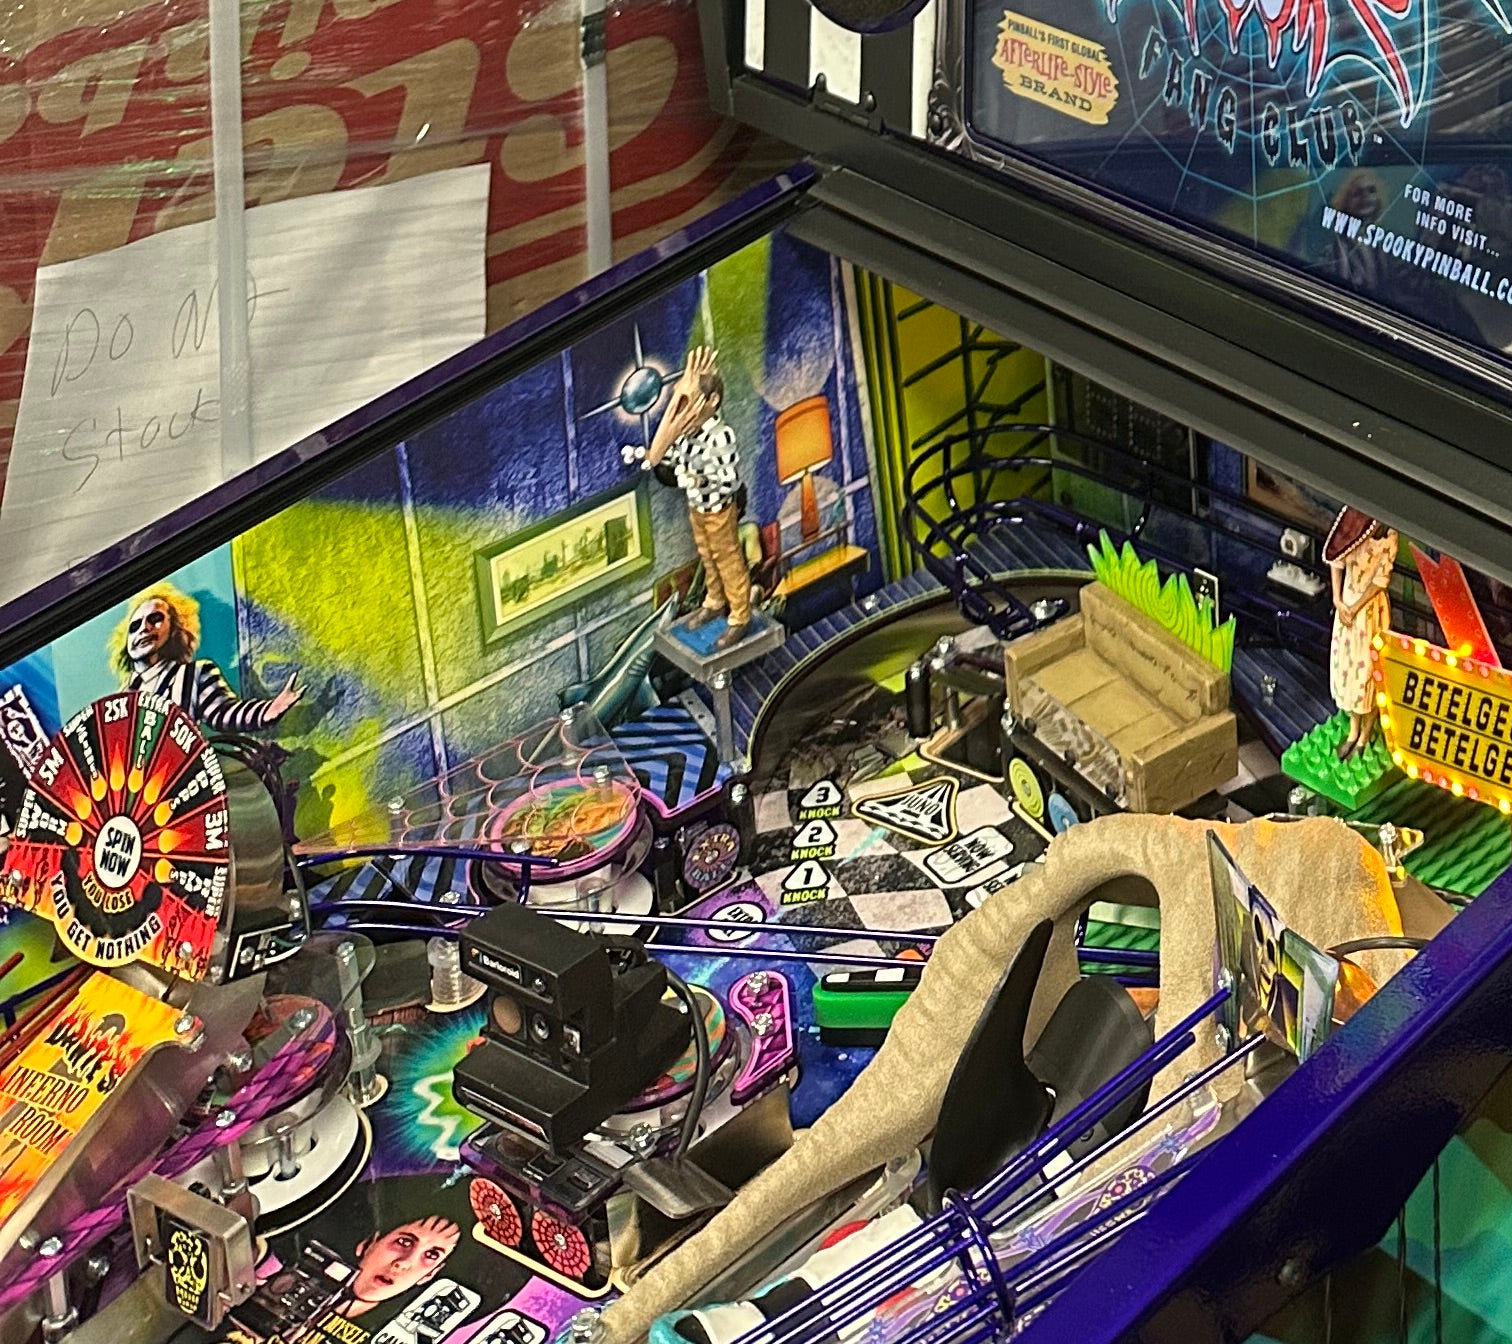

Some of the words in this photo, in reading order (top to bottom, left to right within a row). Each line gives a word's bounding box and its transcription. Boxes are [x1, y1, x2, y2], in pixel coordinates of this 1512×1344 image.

[1008, 19, 1046, 41] PINBALL'S
[1048, 33, 1070, 50] FIRST
[1072, 41, 1100, 62] GLOBAL
[1020, 75, 1092, 112] BRAND
[1262, 100, 1365, 175] CLUB
[1404, 183, 1429, 208] FOR
[1432, 191, 1472, 224] MORE
[1415, 209, 1447, 238] INFO
[1450, 218, 1500, 257] VISIT...
[105, 697, 129, 723] 25K
[138, 692, 172, 716] EXTRA
[169, 719, 197, 754] 50K
[39, 747, 65, 785] 5M
[816, 787, 830, 804] 3
[902, 793, 941, 817] JUNO
[799, 807, 841, 820] KNOCK
[106, 827, 135, 855] SPIN
[808, 826, 822, 843] 2
[100, 849, 131, 877] NOW
[791, 845, 833, 860] KNOCK
[803, 868, 816, 885] 1
[83, 874, 101, 906] YOU
[105, 890, 132, 911] LOSE
[782, 888, 826, 903] KNOCK
[51, 873, 70, 919] YOU
[67, 920, 92, 952] GET
[95, 915, 162, 960] NOTHING
[1, 1066, 89, 1113] INFERNO
[9, 1106, 69, 1155] ROOM
